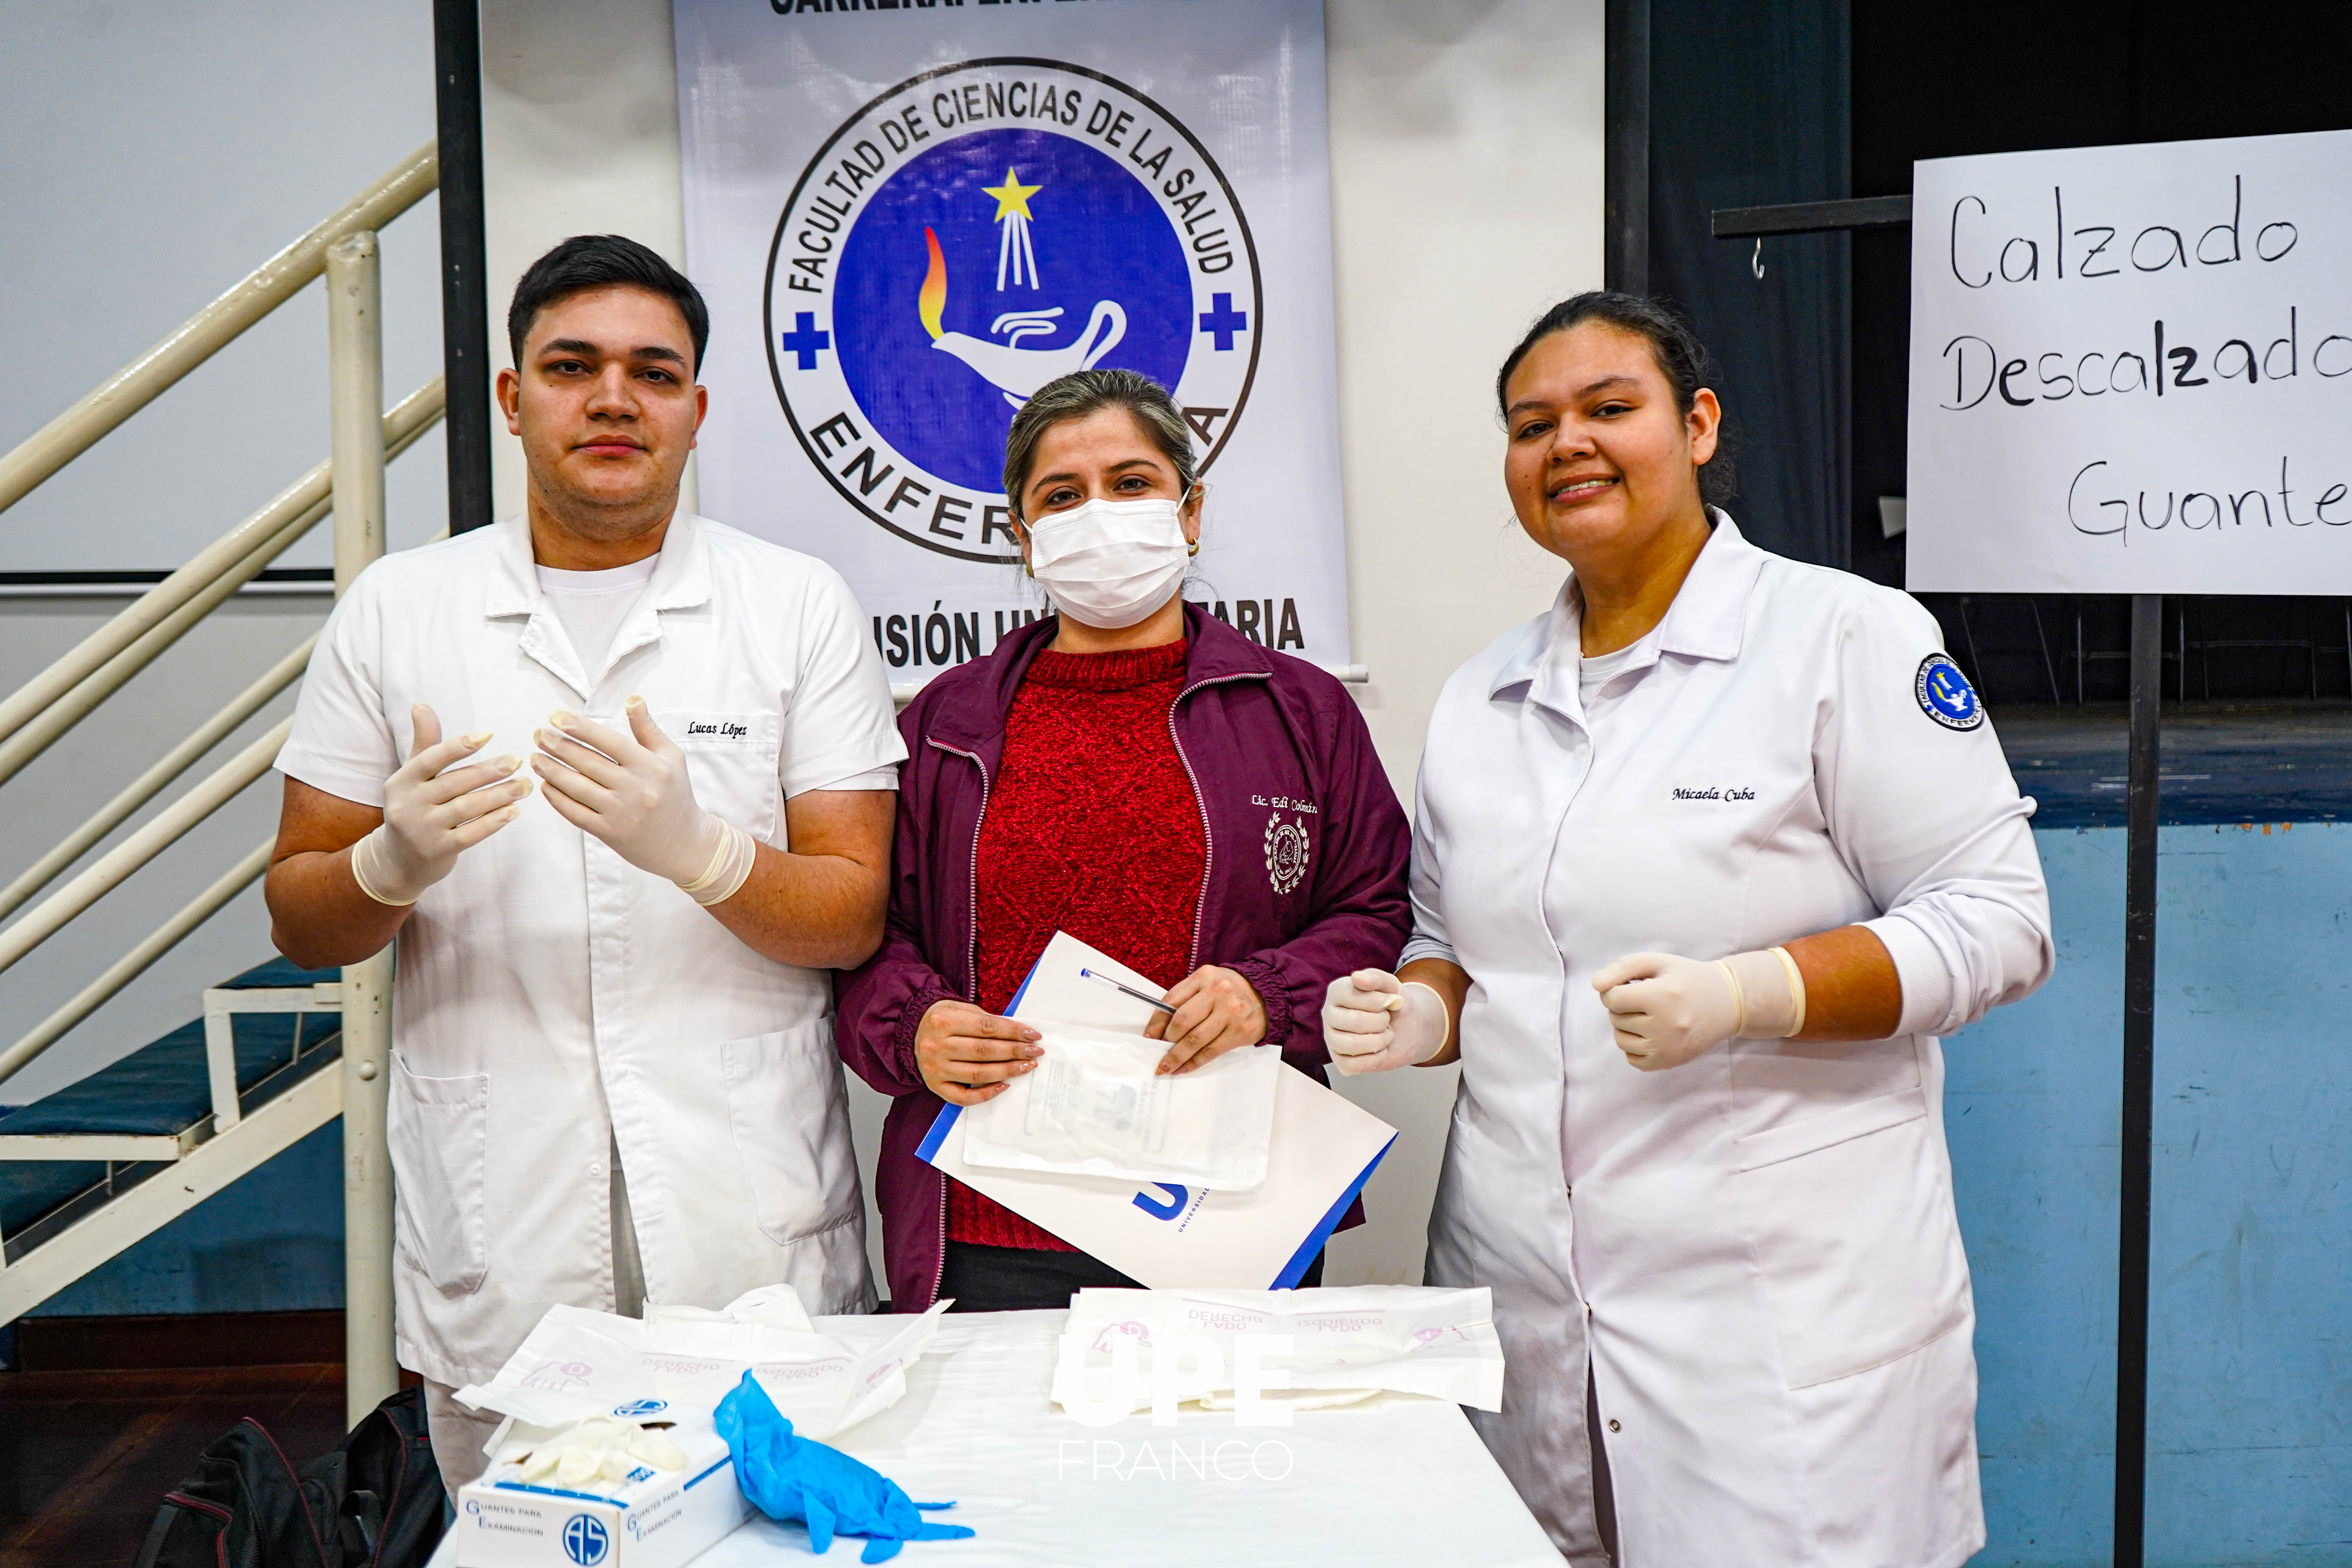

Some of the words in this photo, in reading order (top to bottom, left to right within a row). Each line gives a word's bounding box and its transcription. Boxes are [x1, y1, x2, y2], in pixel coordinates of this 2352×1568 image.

[788, 140, 885, 293] FACULTAD
[879, 104, 930, 154] DE
[933, 81, 1082, 128] CIENCIAS
[1085, 99, 1135, 148] DE
[1128, 128, 1174, 180] LA
[1163, 168, 1234, 274] SALUD
[1951, 174, 2298, 288] Calzado
[1940, 306, 2352, 411] Descalzado
[688, 721, 717, 734] Lucas
[720, 722, 747, 739] López
[1671, 787, 1720, 800] Micaela
[1724, 787, 1755, 802] Cuba
[466, 1499, 515, 1515] GUANTES
